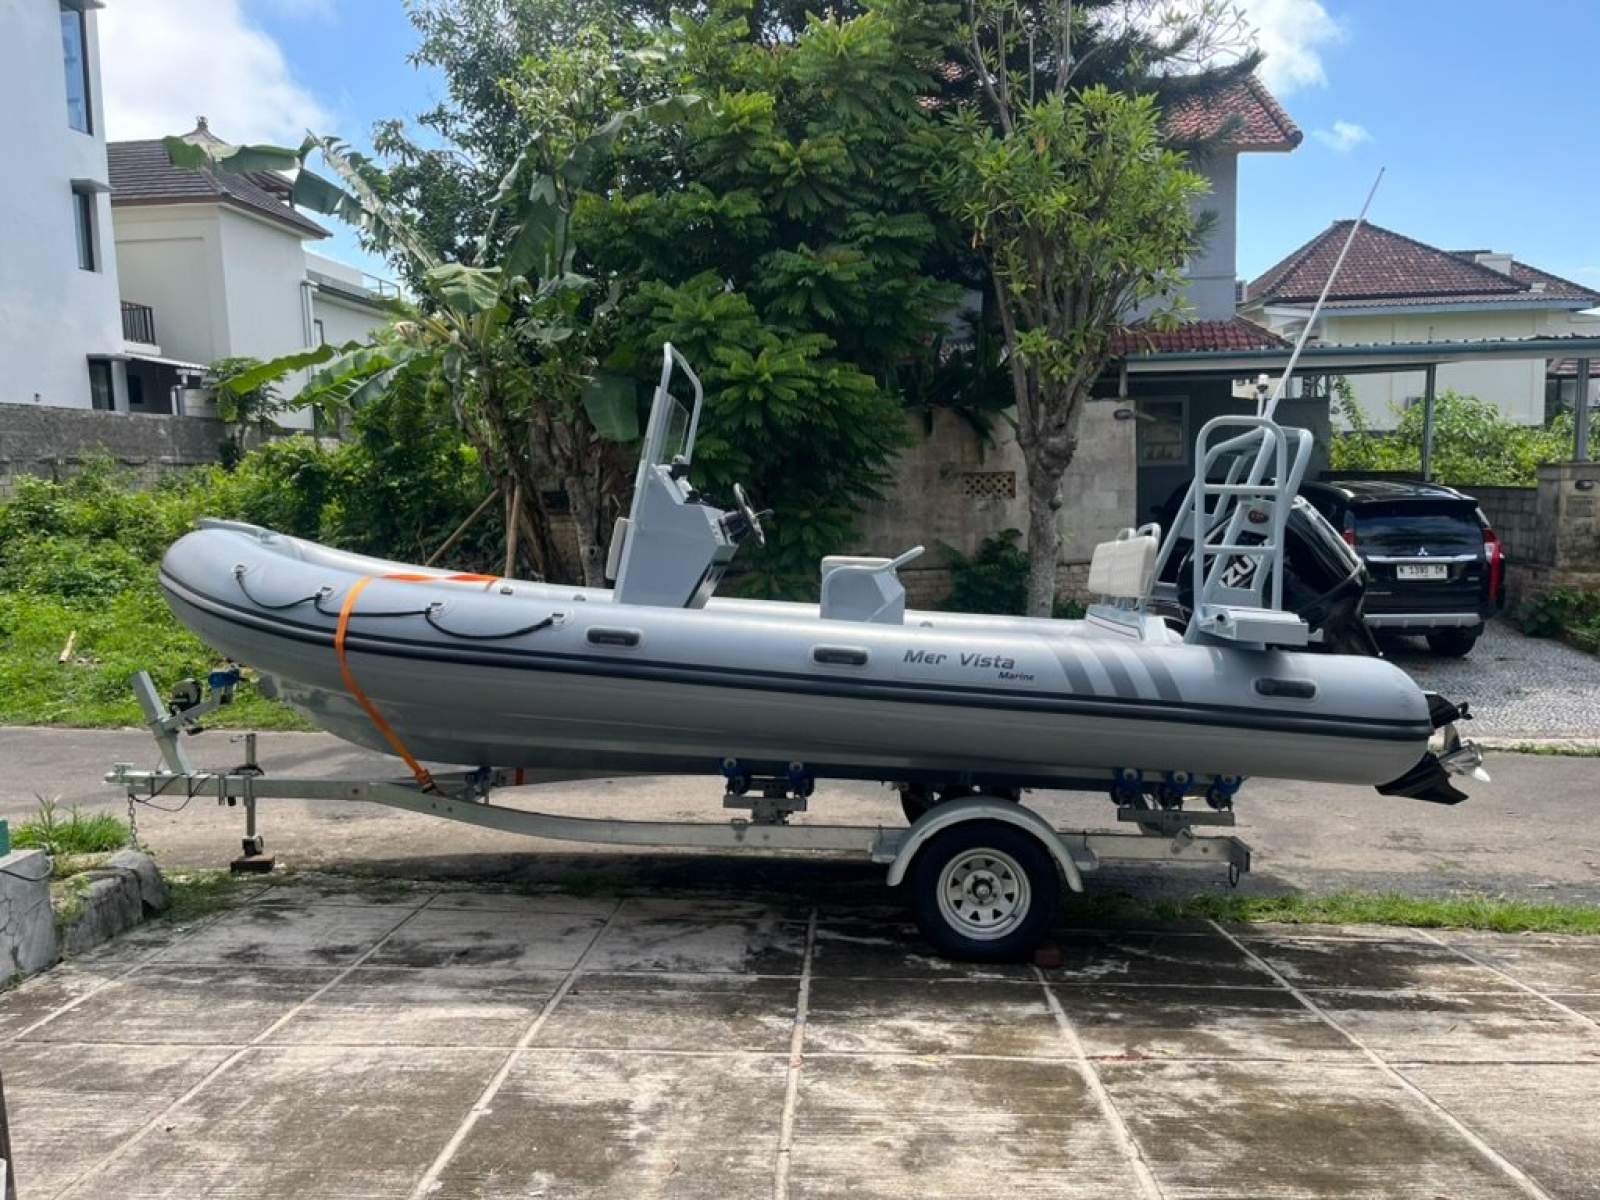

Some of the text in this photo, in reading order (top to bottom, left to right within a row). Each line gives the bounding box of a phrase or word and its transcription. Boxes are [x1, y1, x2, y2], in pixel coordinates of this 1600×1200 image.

[903, 649, 1015, 670] Mer Vista
[998, 671, 1035, 681] Marine
